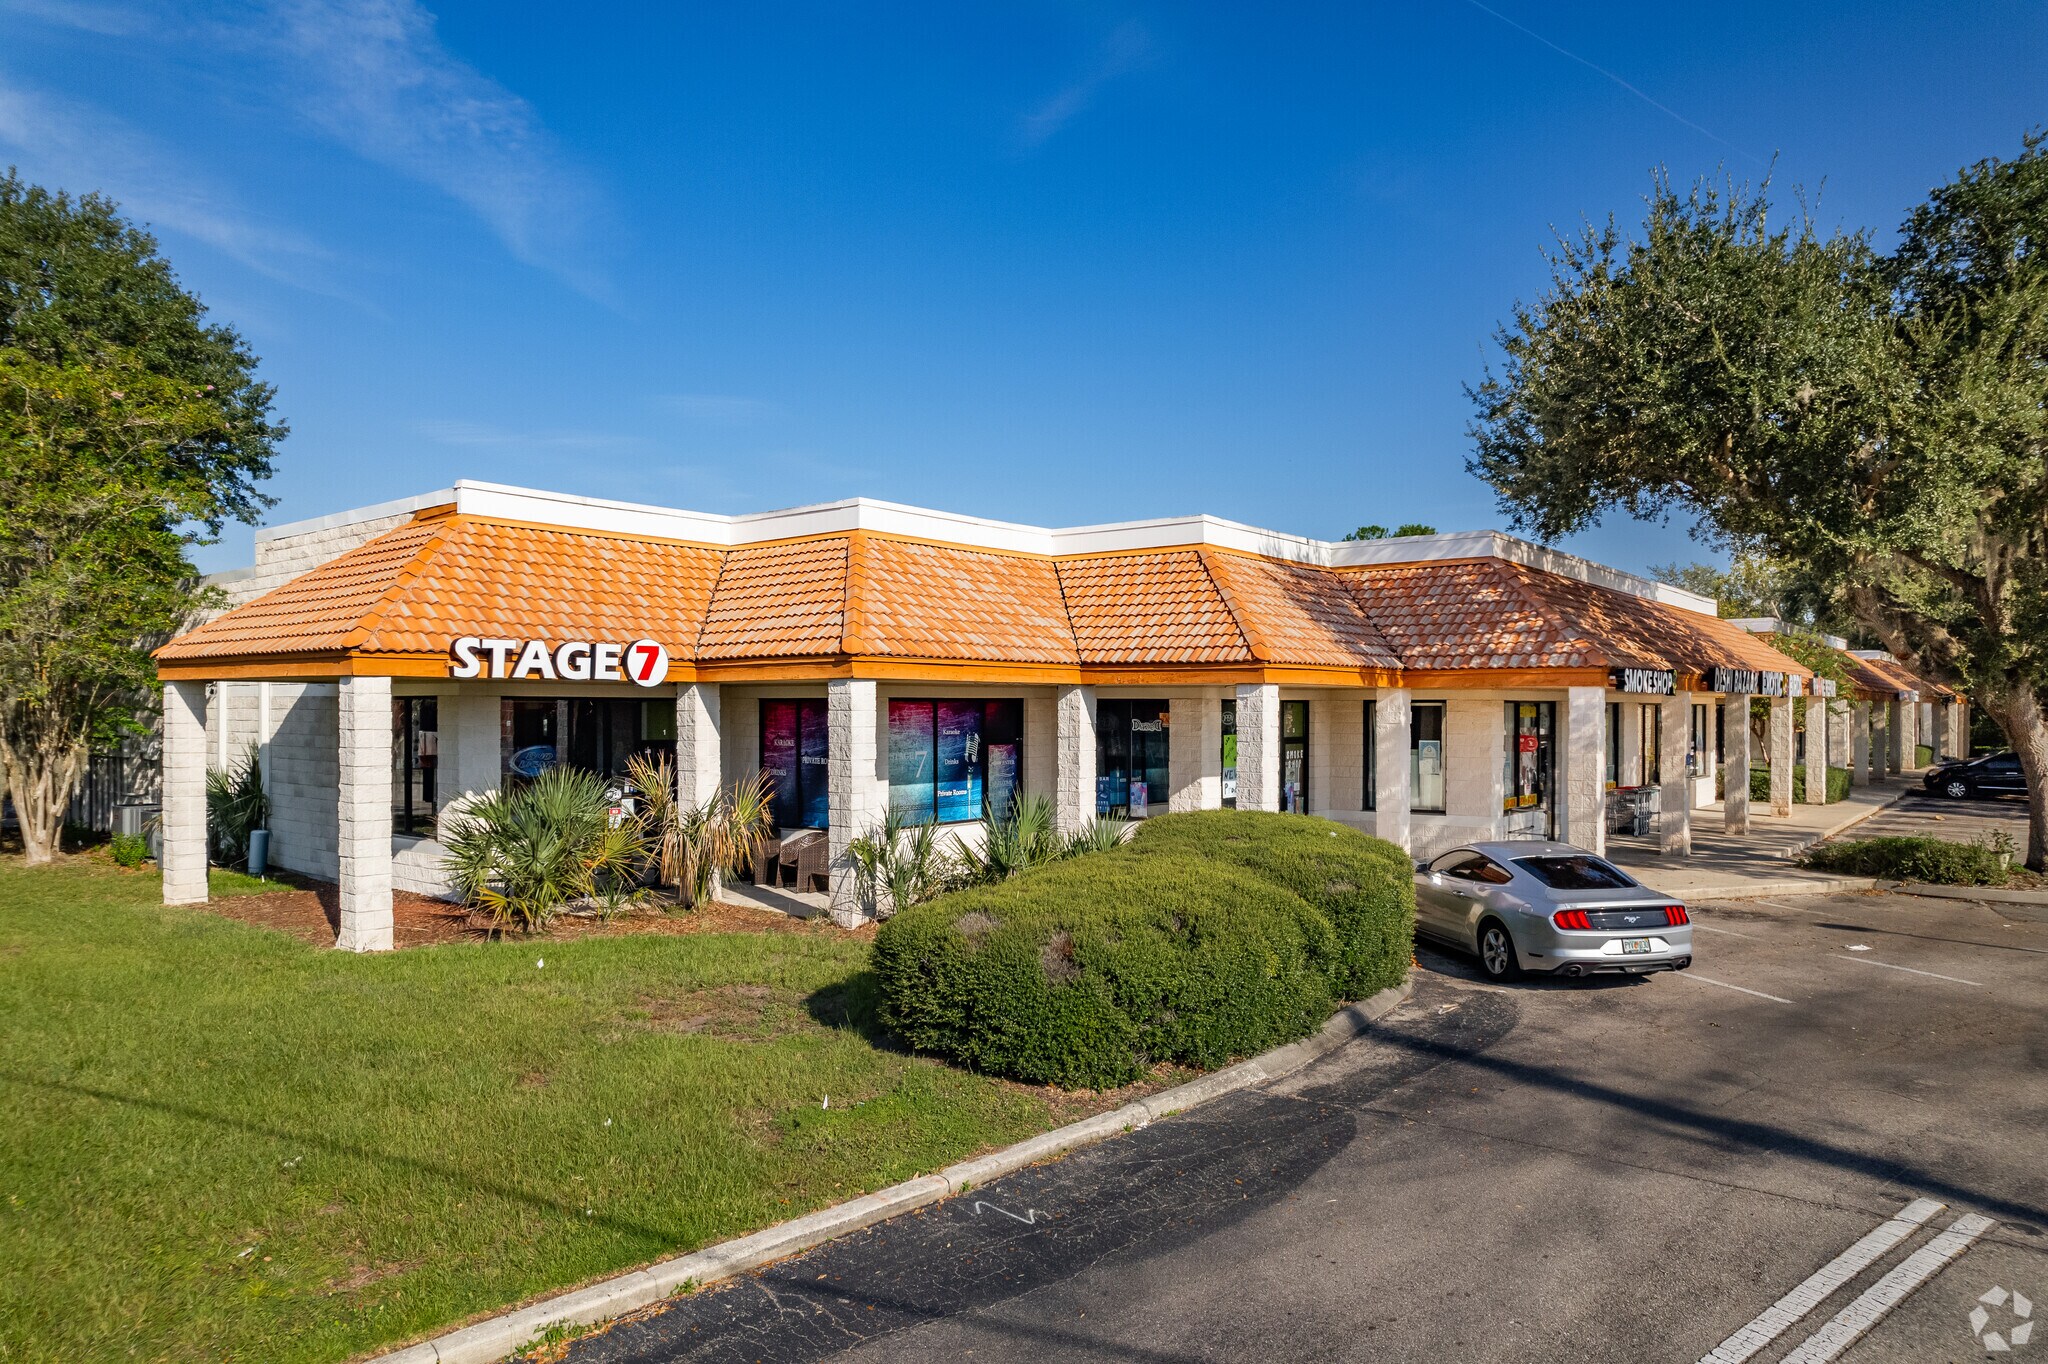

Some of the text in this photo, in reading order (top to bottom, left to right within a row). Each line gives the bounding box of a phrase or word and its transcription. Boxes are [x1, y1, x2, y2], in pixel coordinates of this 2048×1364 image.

[451, 637, 660, 681] STAGE 7
[1714, 667, 1758, 694] DESHI BAZAAR
[1286, 749, 1303, 759] SMOKE
[802, 756, 820, 764] PRIVATE
[915, 751, 928, 778] 7
[944, 758, 959, 766] Drinks
[937, 788, 967, 797] Private Rooms
